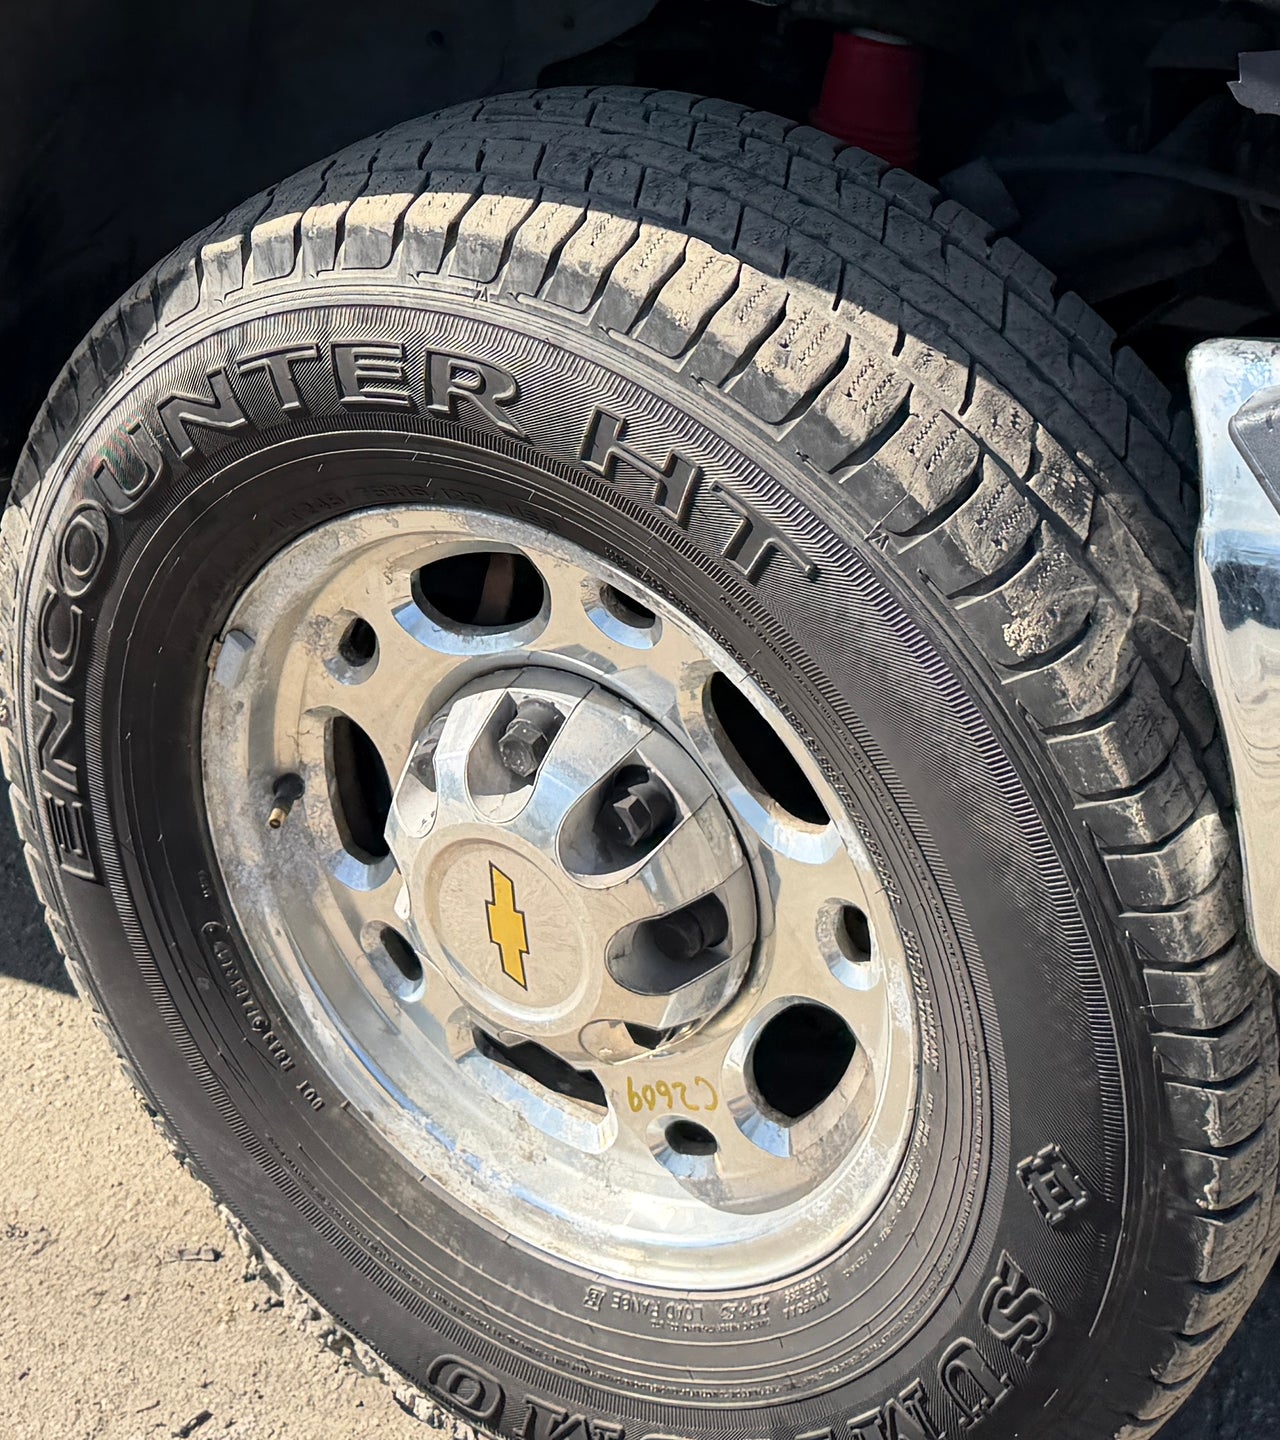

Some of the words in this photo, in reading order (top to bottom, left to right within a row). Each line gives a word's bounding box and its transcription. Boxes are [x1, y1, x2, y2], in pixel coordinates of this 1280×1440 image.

[32, 339, 529, 884] ENCOUNTER
[577, 403, 818, 582] HT
[626, 1075, 719, 1113] C2609
[426, 1250, 1054, 1440] SUMMO
